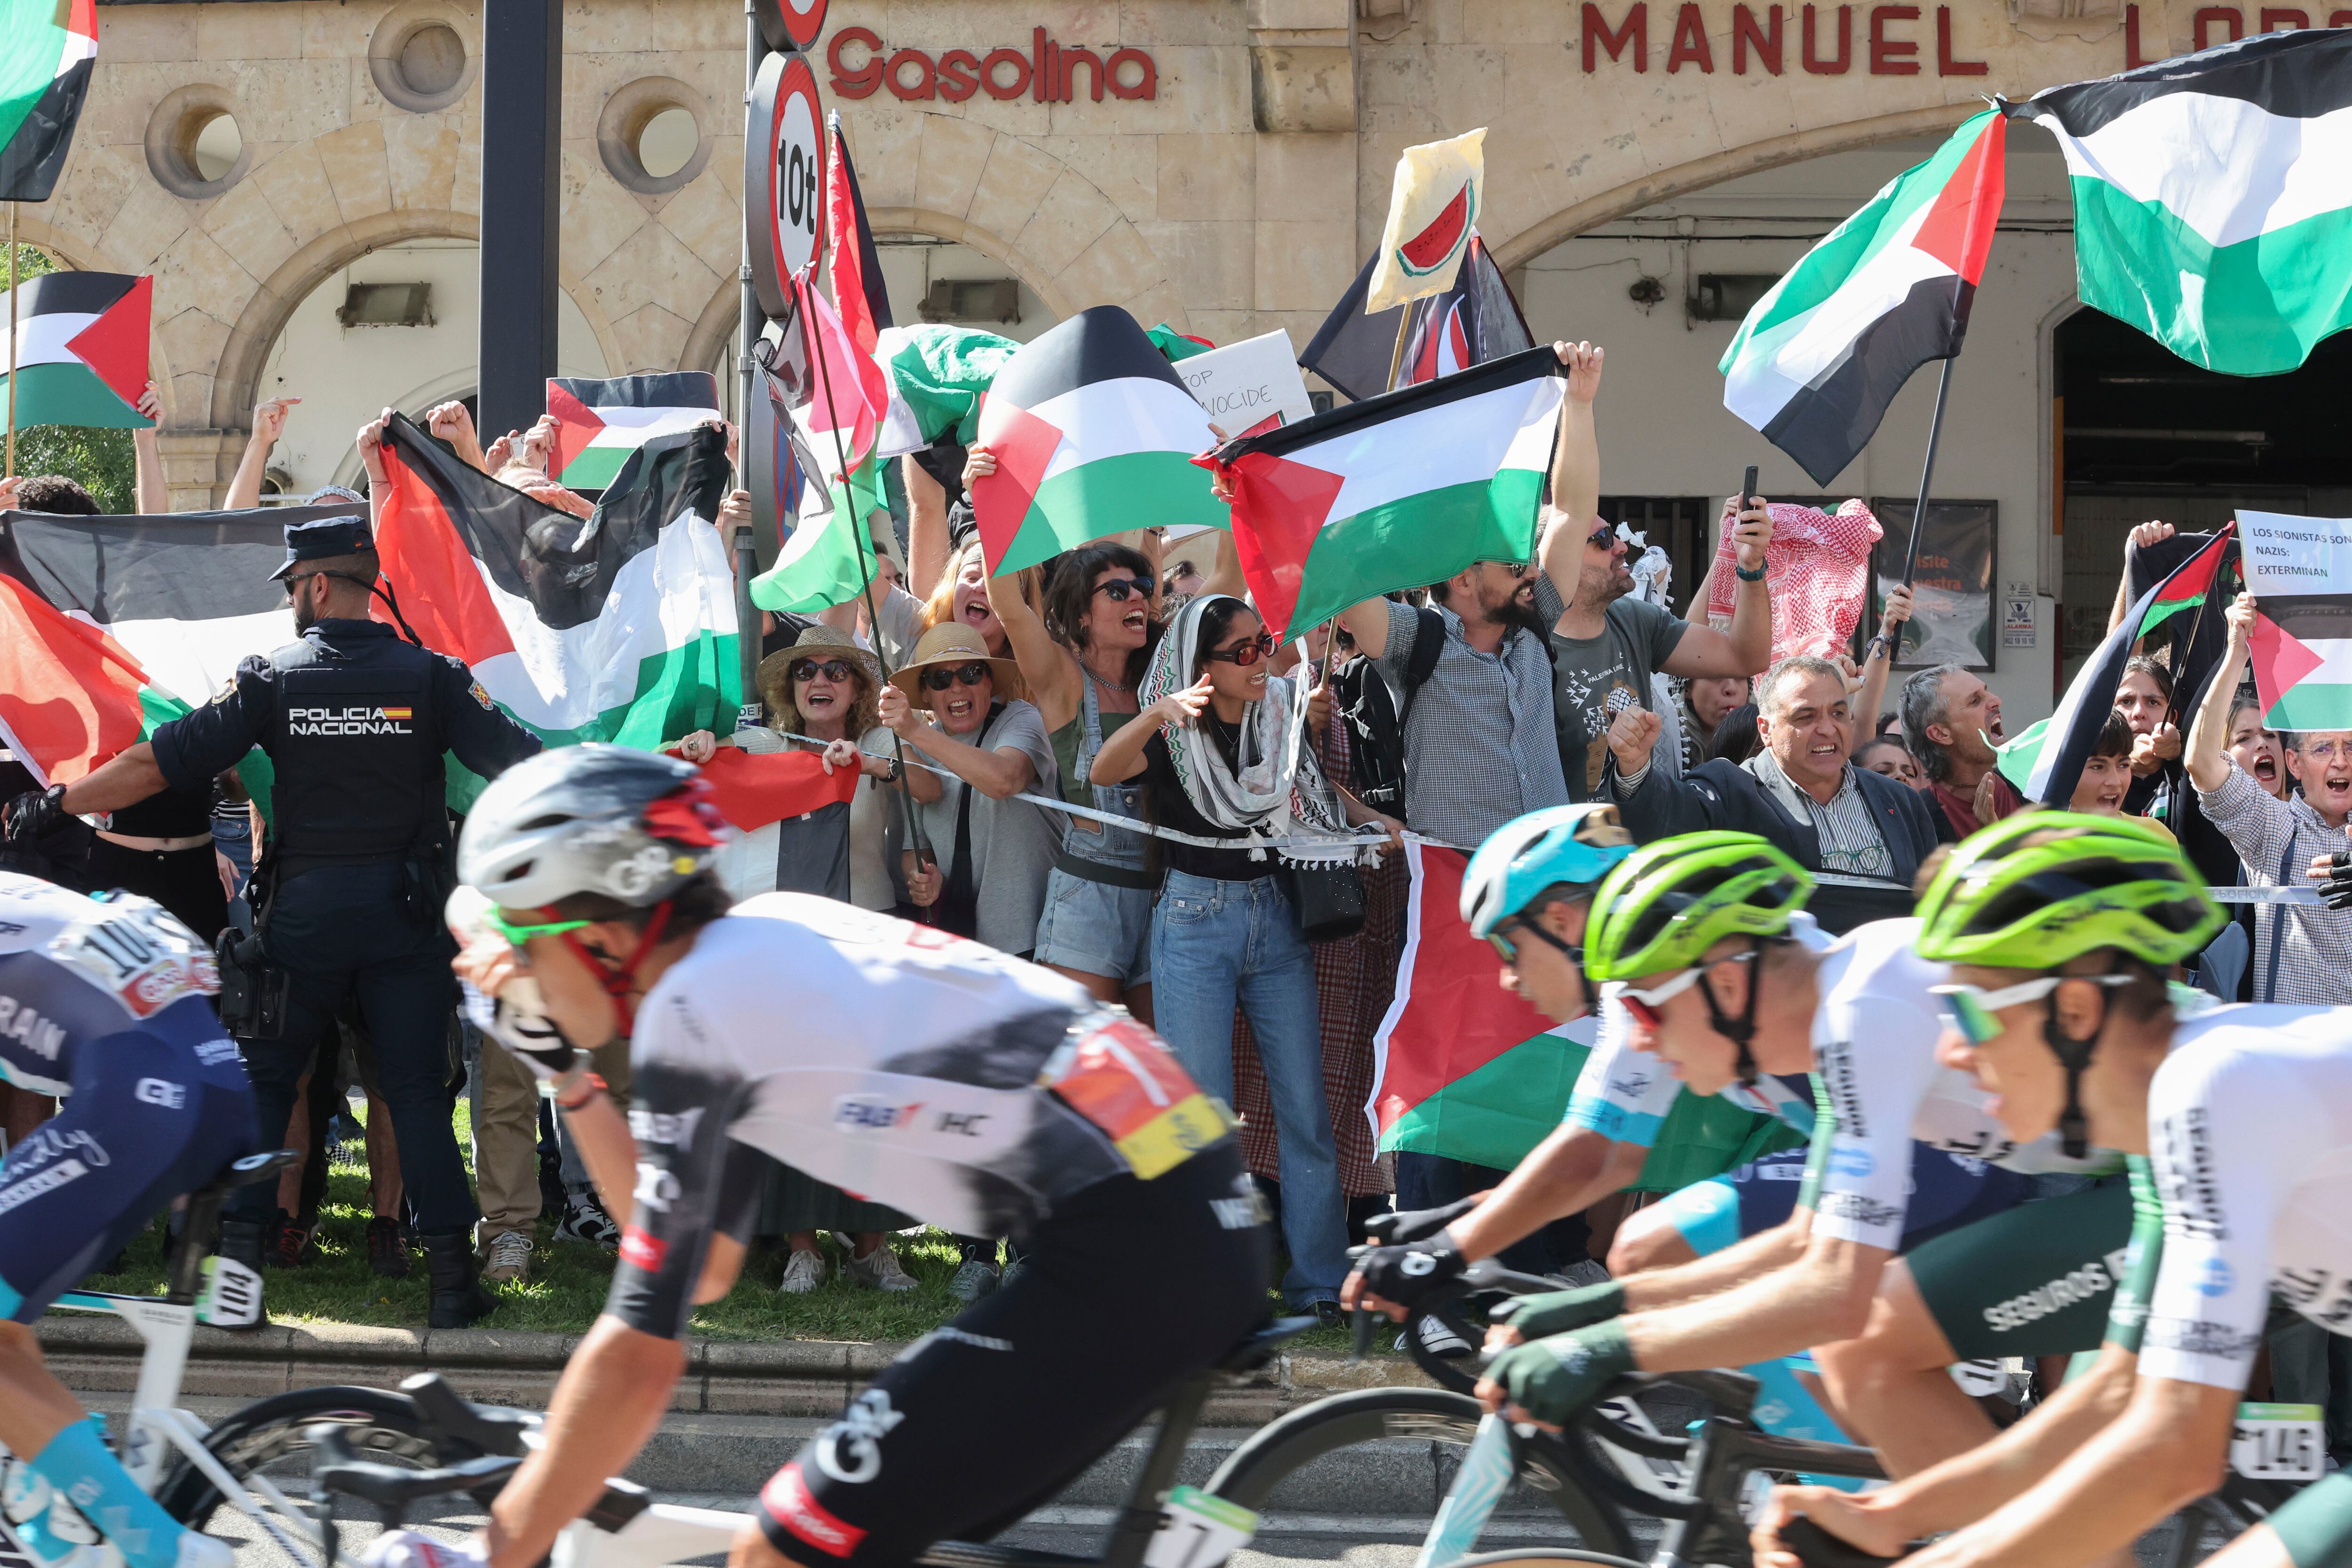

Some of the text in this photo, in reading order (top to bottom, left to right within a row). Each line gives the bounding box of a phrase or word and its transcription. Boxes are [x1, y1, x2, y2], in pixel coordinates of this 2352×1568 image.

[1581, 2, 2352, 77] MANUEL LO
[826, 26, 1156, 103] Gasolina
[778, 138, 816, 234] 10t
[2253, 528, 2352, 544] LOS SIONISTAS SON
[2256, 546, 2290, 557] NAZIS:
[1905, 554, 1949, 569] isite
[2258, 565, 2328, 577] EXTERMINAN
[289, 722, 413, 735] NACIONAL
